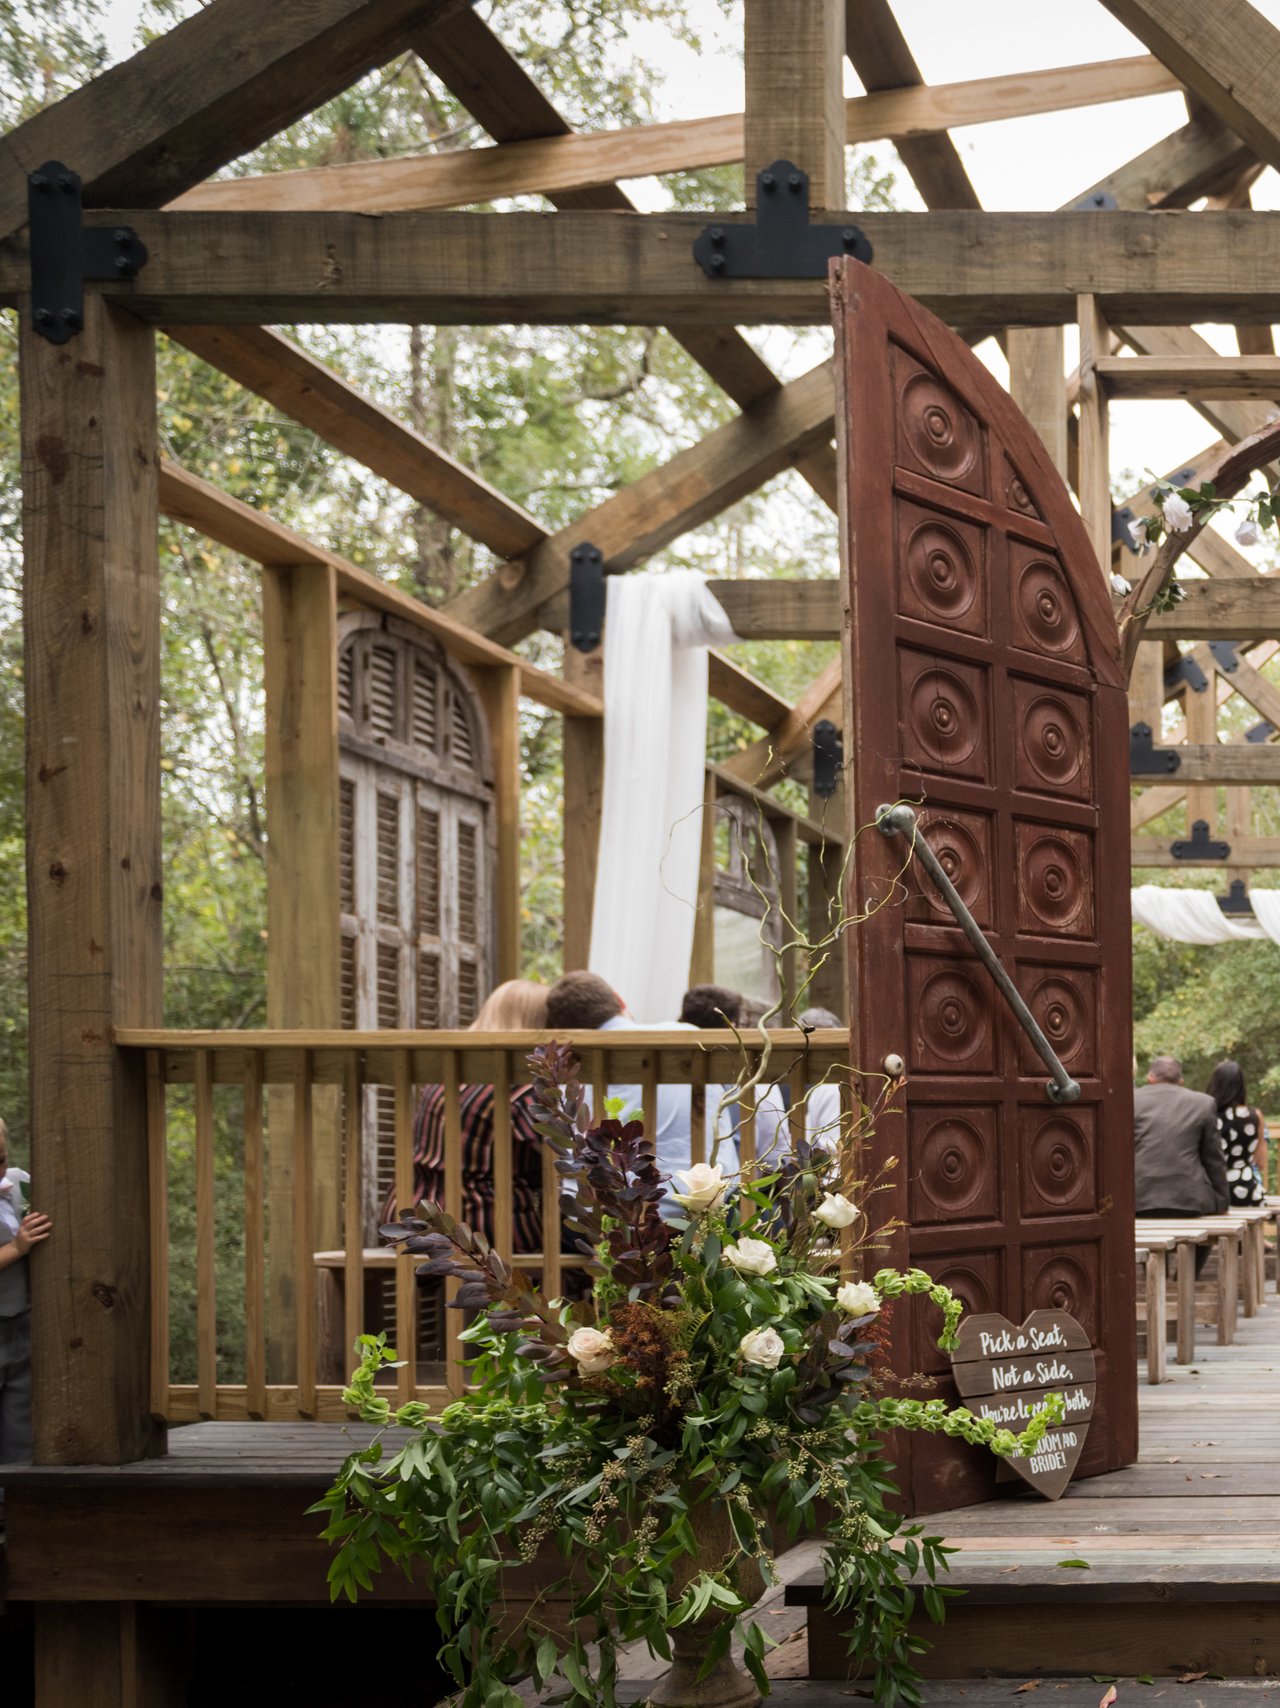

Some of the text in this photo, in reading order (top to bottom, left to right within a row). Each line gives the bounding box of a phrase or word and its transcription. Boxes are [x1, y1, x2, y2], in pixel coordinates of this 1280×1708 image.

[979, 1323, 1068, 1356] Pick a Seat,
[991, 1359, 1074, 1390] Not a Side,
[1064, 1388, 1091, 1411] both
[1062, 1431, 1078, 1448] AND
[1029, 1448, 1067, 1474] BRIDE!
